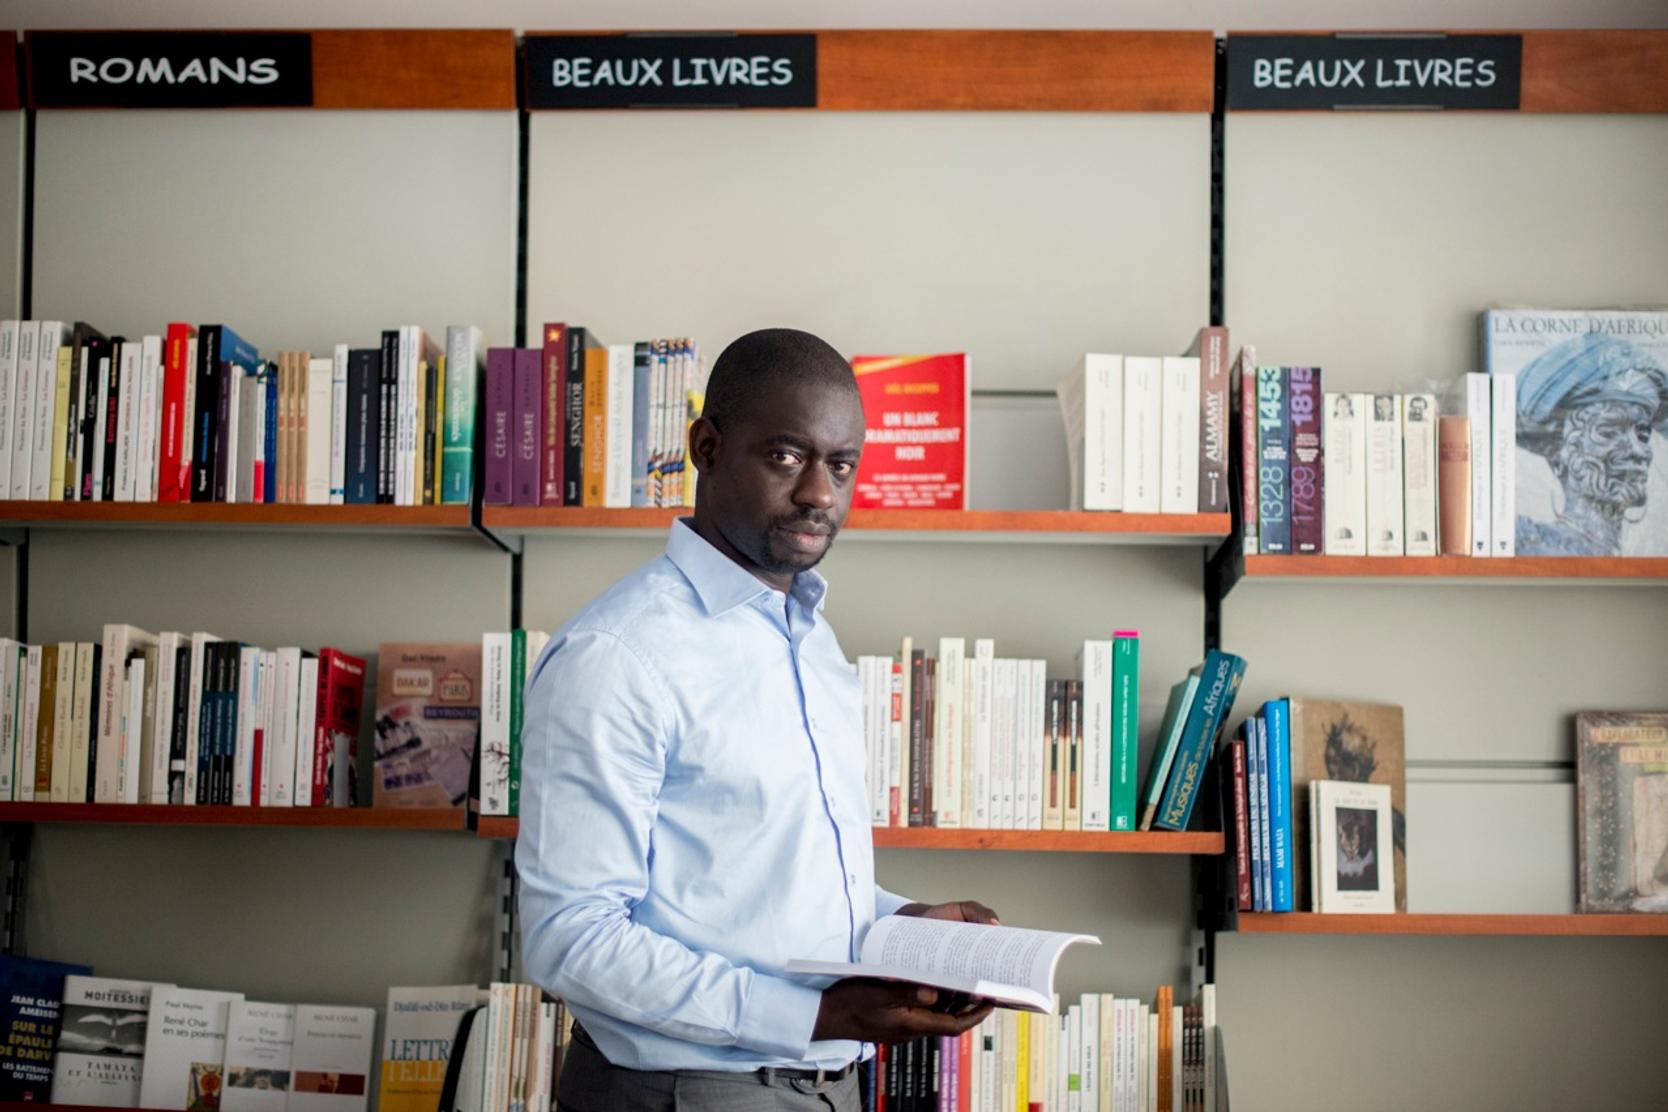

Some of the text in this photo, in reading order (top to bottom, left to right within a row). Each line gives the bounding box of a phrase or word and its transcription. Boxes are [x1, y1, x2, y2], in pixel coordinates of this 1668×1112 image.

[69, 57, 281, 84] ROMANS
[552, 57, 794, 87] BEAUX LIVRES
[1253, 57, 1497, 88] BEAUX LIVRES
[1495, 317, 1518, 334] LA
[1521, 317, 1583, 335] CORNE
[1260, 368, 1283, 433] 1453
[1290, 368, 1313, 427] 1815
[569, 382, 583, 448] SENGHOR
[883, 411, 940, 427] UN BLANC
[495, 411, 507, 459] CÉSAIRE
[523, 412, 535, 460] CÉSAIRE
[1204, 390, 1219, 462] ALMAMY
[895, 445, 925, 461] NOIR
[1260, 466, 1284, 526] 1328
[1291, 466, 1316, 525] 1789
[396, 677, 428, 688] DAKAR
[103, 663, 115, 737] Mémoires d'Afrique
[425, 707, 480, 718] BEYROUTH
[1168, 761, 1200, 825] Musiques
[1203, 659, 1231, 716] Afriques
[11, 995, 35, 1007] JEAN
[84, 991, 149, 1006] MOITESSIE
[11, 1020, 38, 1034] SUR
[163, 1016, 208, 1028] René Char
[176, 1029, 193, 1037] ses
[196, 1029, 226, 1041] poèmes
[390, 1039, 453, 1061] LETTR
[3, 1062, 15, 1070] LES
[68, 1069, 80, 1077] ET
[87, 1061, 137, 1073] TAMATA
[12, 1071, 48, 1083] DU TEMPS
